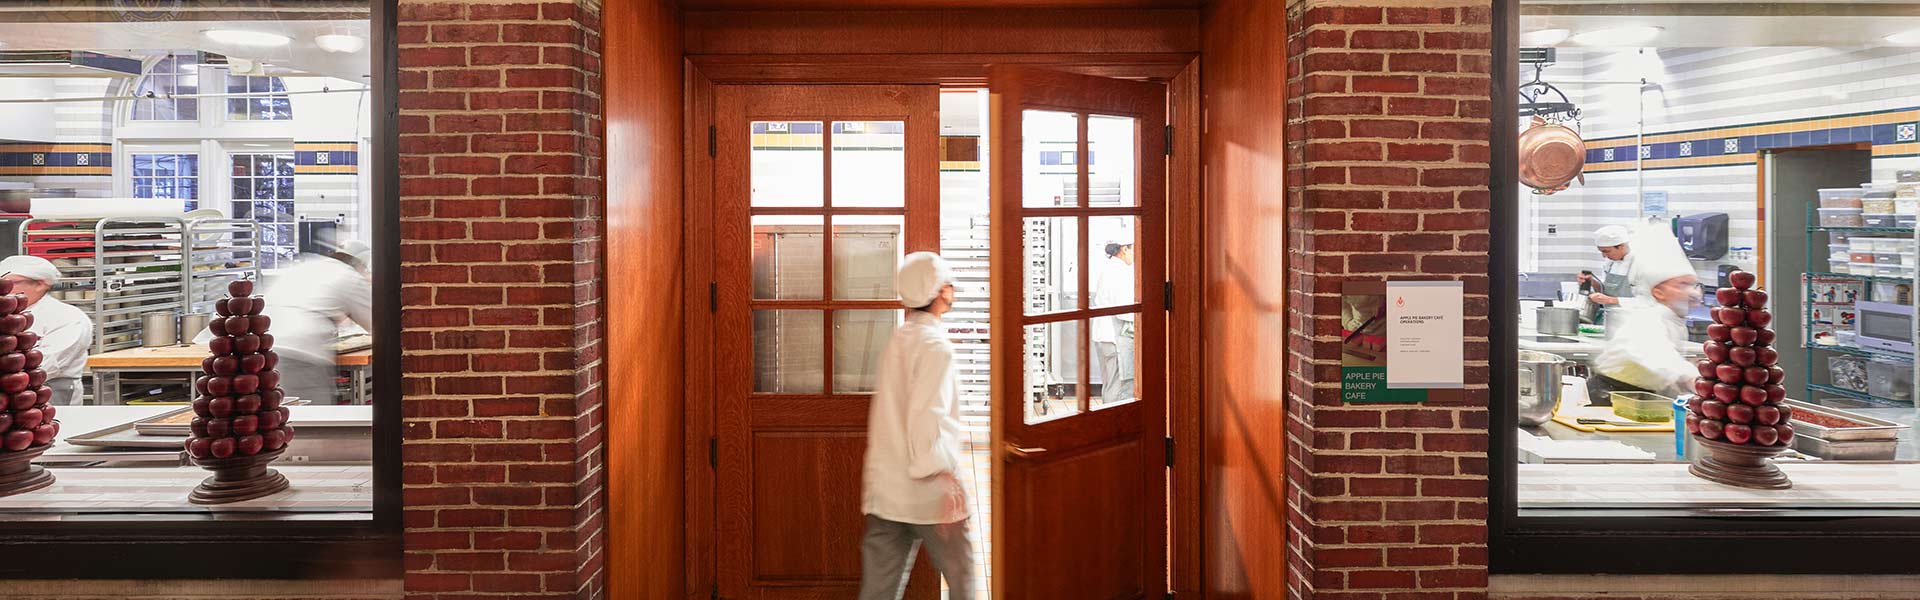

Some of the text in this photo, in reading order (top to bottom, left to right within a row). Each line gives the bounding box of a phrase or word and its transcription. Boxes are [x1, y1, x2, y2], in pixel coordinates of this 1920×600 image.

[1345, 372, 1385, 380] APPLE PIE
[1345, 382, 1377, 390] BAKERY
[1345, 392, 1366, 400] CAFE
